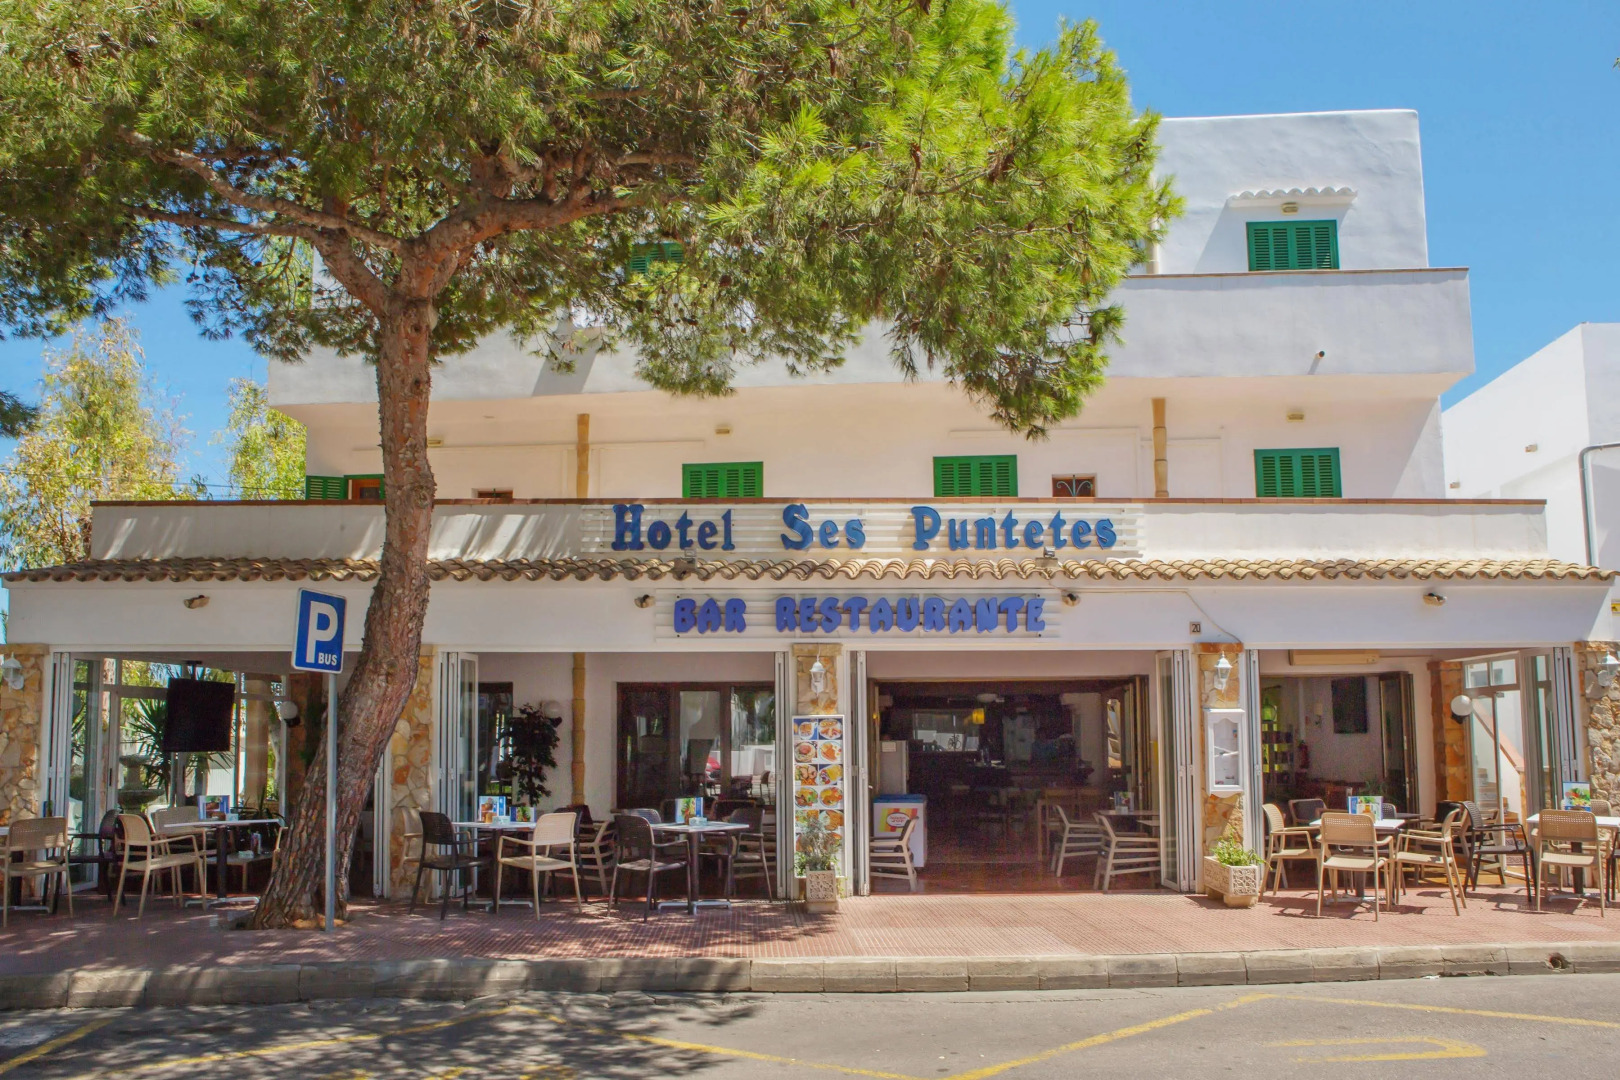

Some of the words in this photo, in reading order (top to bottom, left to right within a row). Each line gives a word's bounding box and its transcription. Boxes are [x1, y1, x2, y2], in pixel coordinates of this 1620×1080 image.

[612, 504, 735, 550] Hotel
[781, 504, 866, 550] Ses
[911, 505, 1118, 550] Puntetes
[306, 601, 338, 663] P
[673, 597, 747, 634] BAR
[775, 596, 1046, 634] RESTAURANTE
[1191, 623, 1201, 633] 20
[318, 653, 337, 665] BUS
